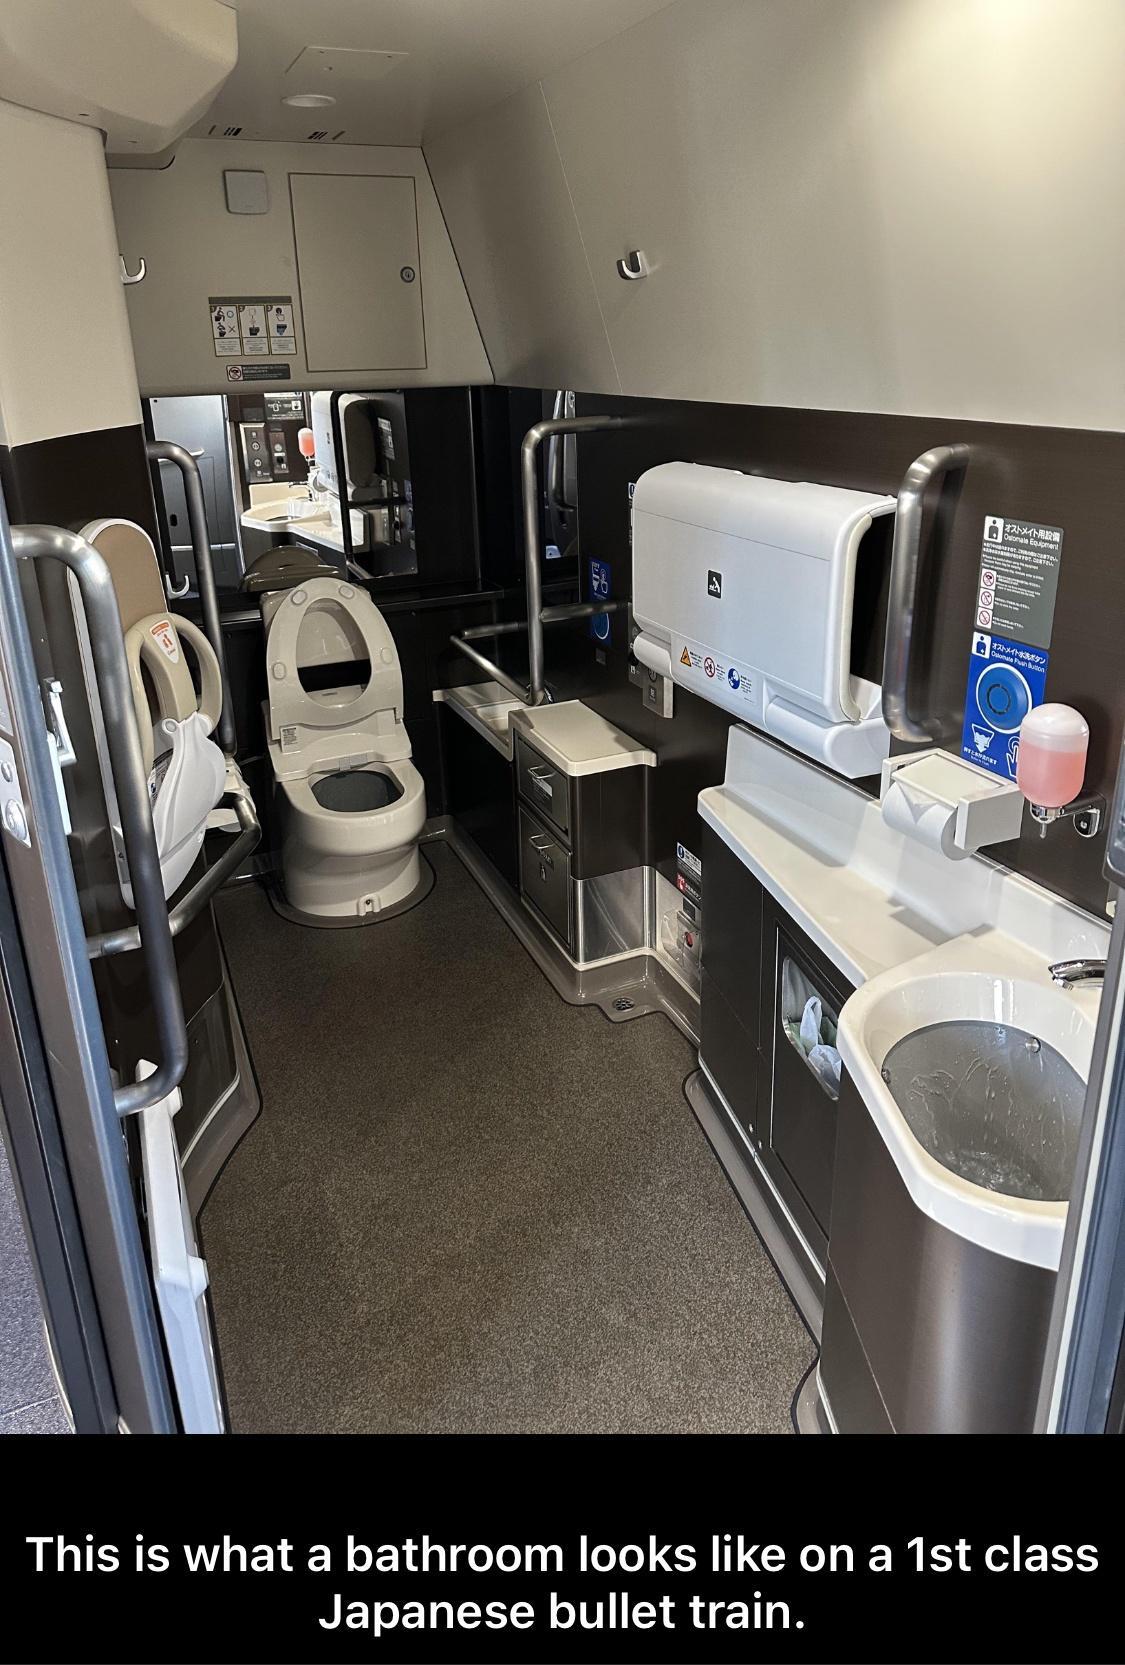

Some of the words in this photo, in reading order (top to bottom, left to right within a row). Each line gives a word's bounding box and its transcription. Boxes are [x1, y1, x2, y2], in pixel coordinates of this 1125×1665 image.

[1004, 524, 1060, 543] オストメイト用設備
[1004, 533, 1029, 545] Ostomate
[1029, 538, 1059, 551] Equipment
[991, 651, 1014, 663] Ostomate
[1014, 657, 1028, 668] Flush
[1028, 663, 1045, 673] Button
[992, 642, 1046, 664] オストメイト水洗ボタン
